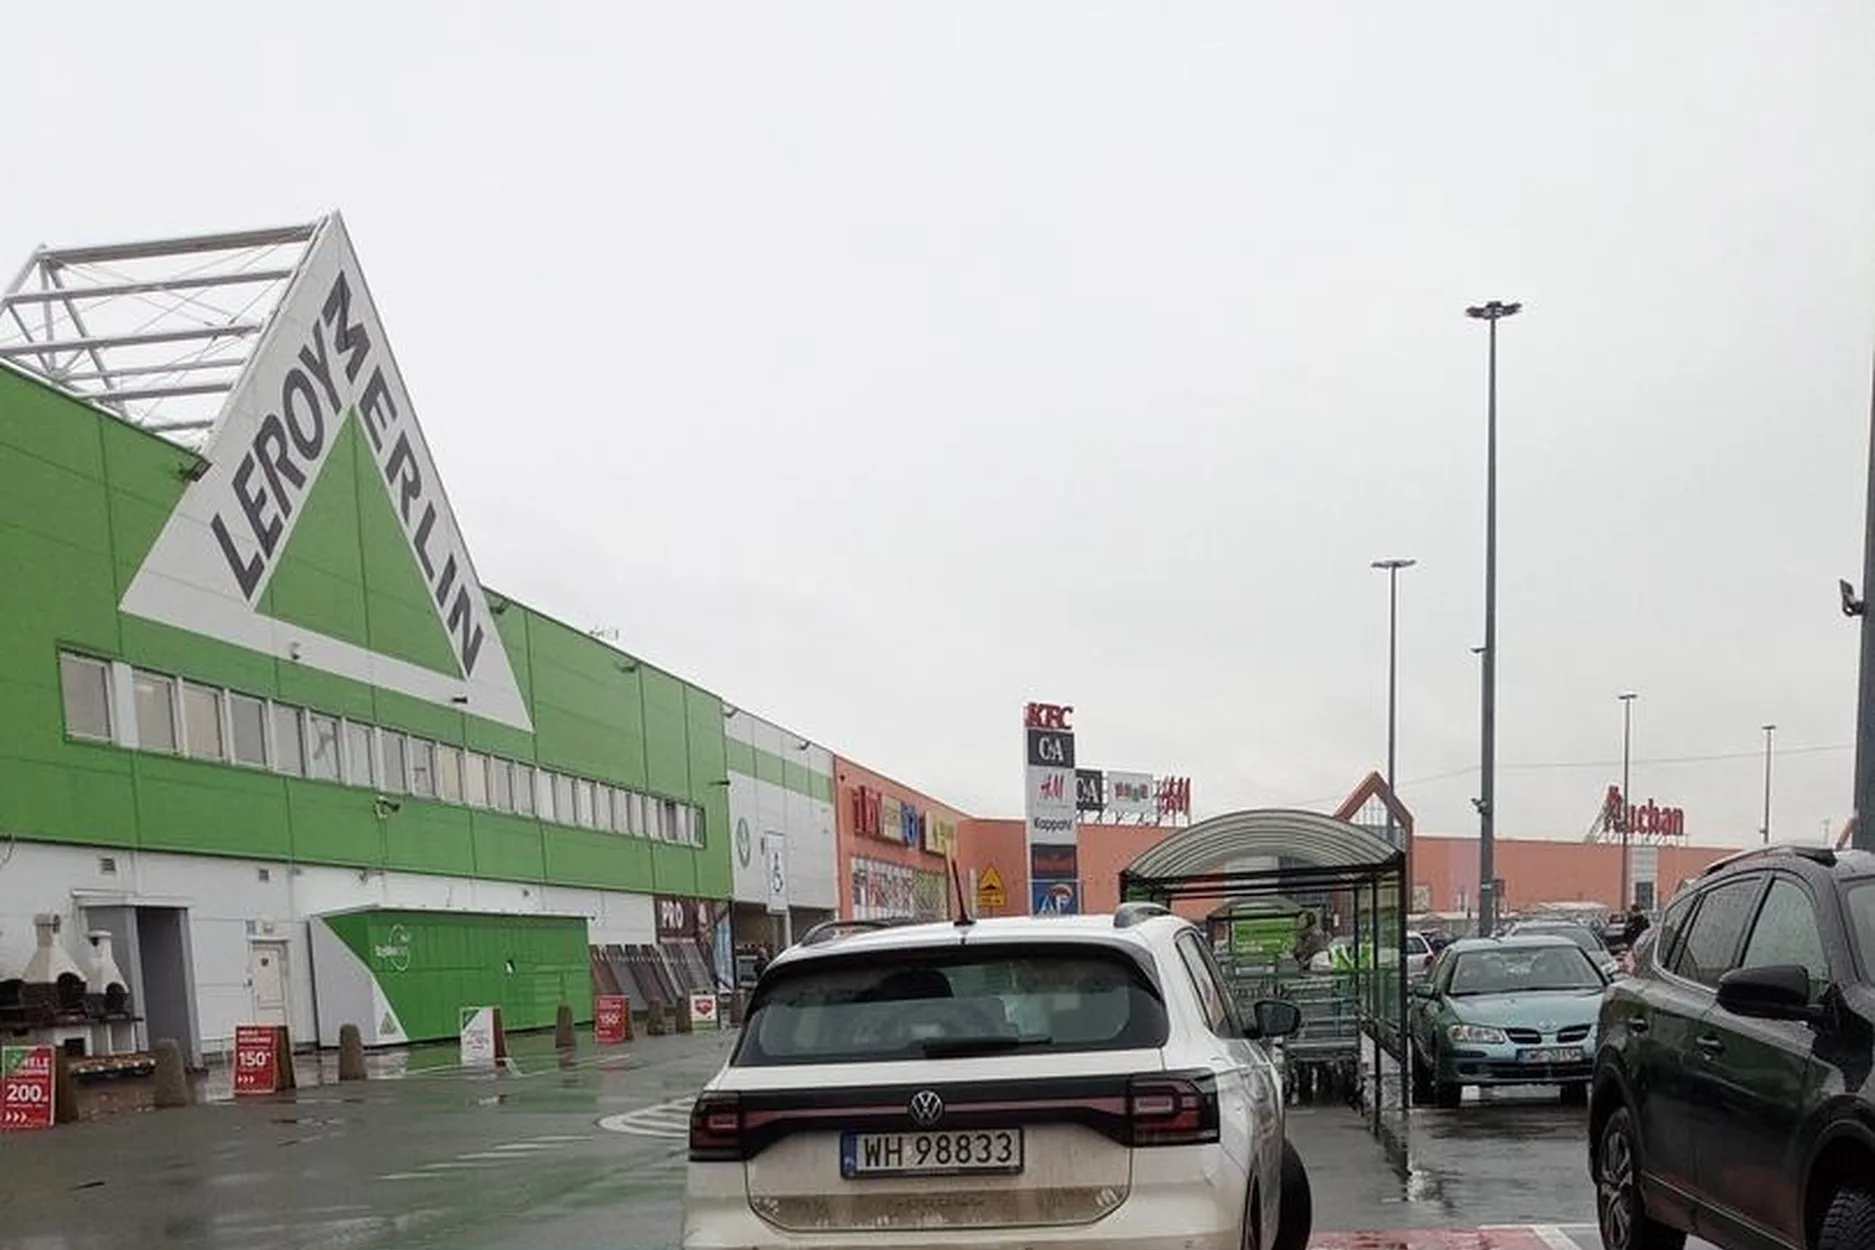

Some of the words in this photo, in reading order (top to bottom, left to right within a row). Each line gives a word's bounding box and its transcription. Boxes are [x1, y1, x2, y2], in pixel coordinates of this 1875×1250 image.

[211, 317, 343, 602] LEROY
[321, 269, 484, 678] MERLIN
[1026, 701, 1074, 730] KFC
[1603, 785, 1684, 836] Auchan
[661, 899, 684, 929] PRO
[6, 1084, 43, 1103] 200
[864, 1135, 903, 1168] WH
[915, 1132, 1013, 1166] 98833
